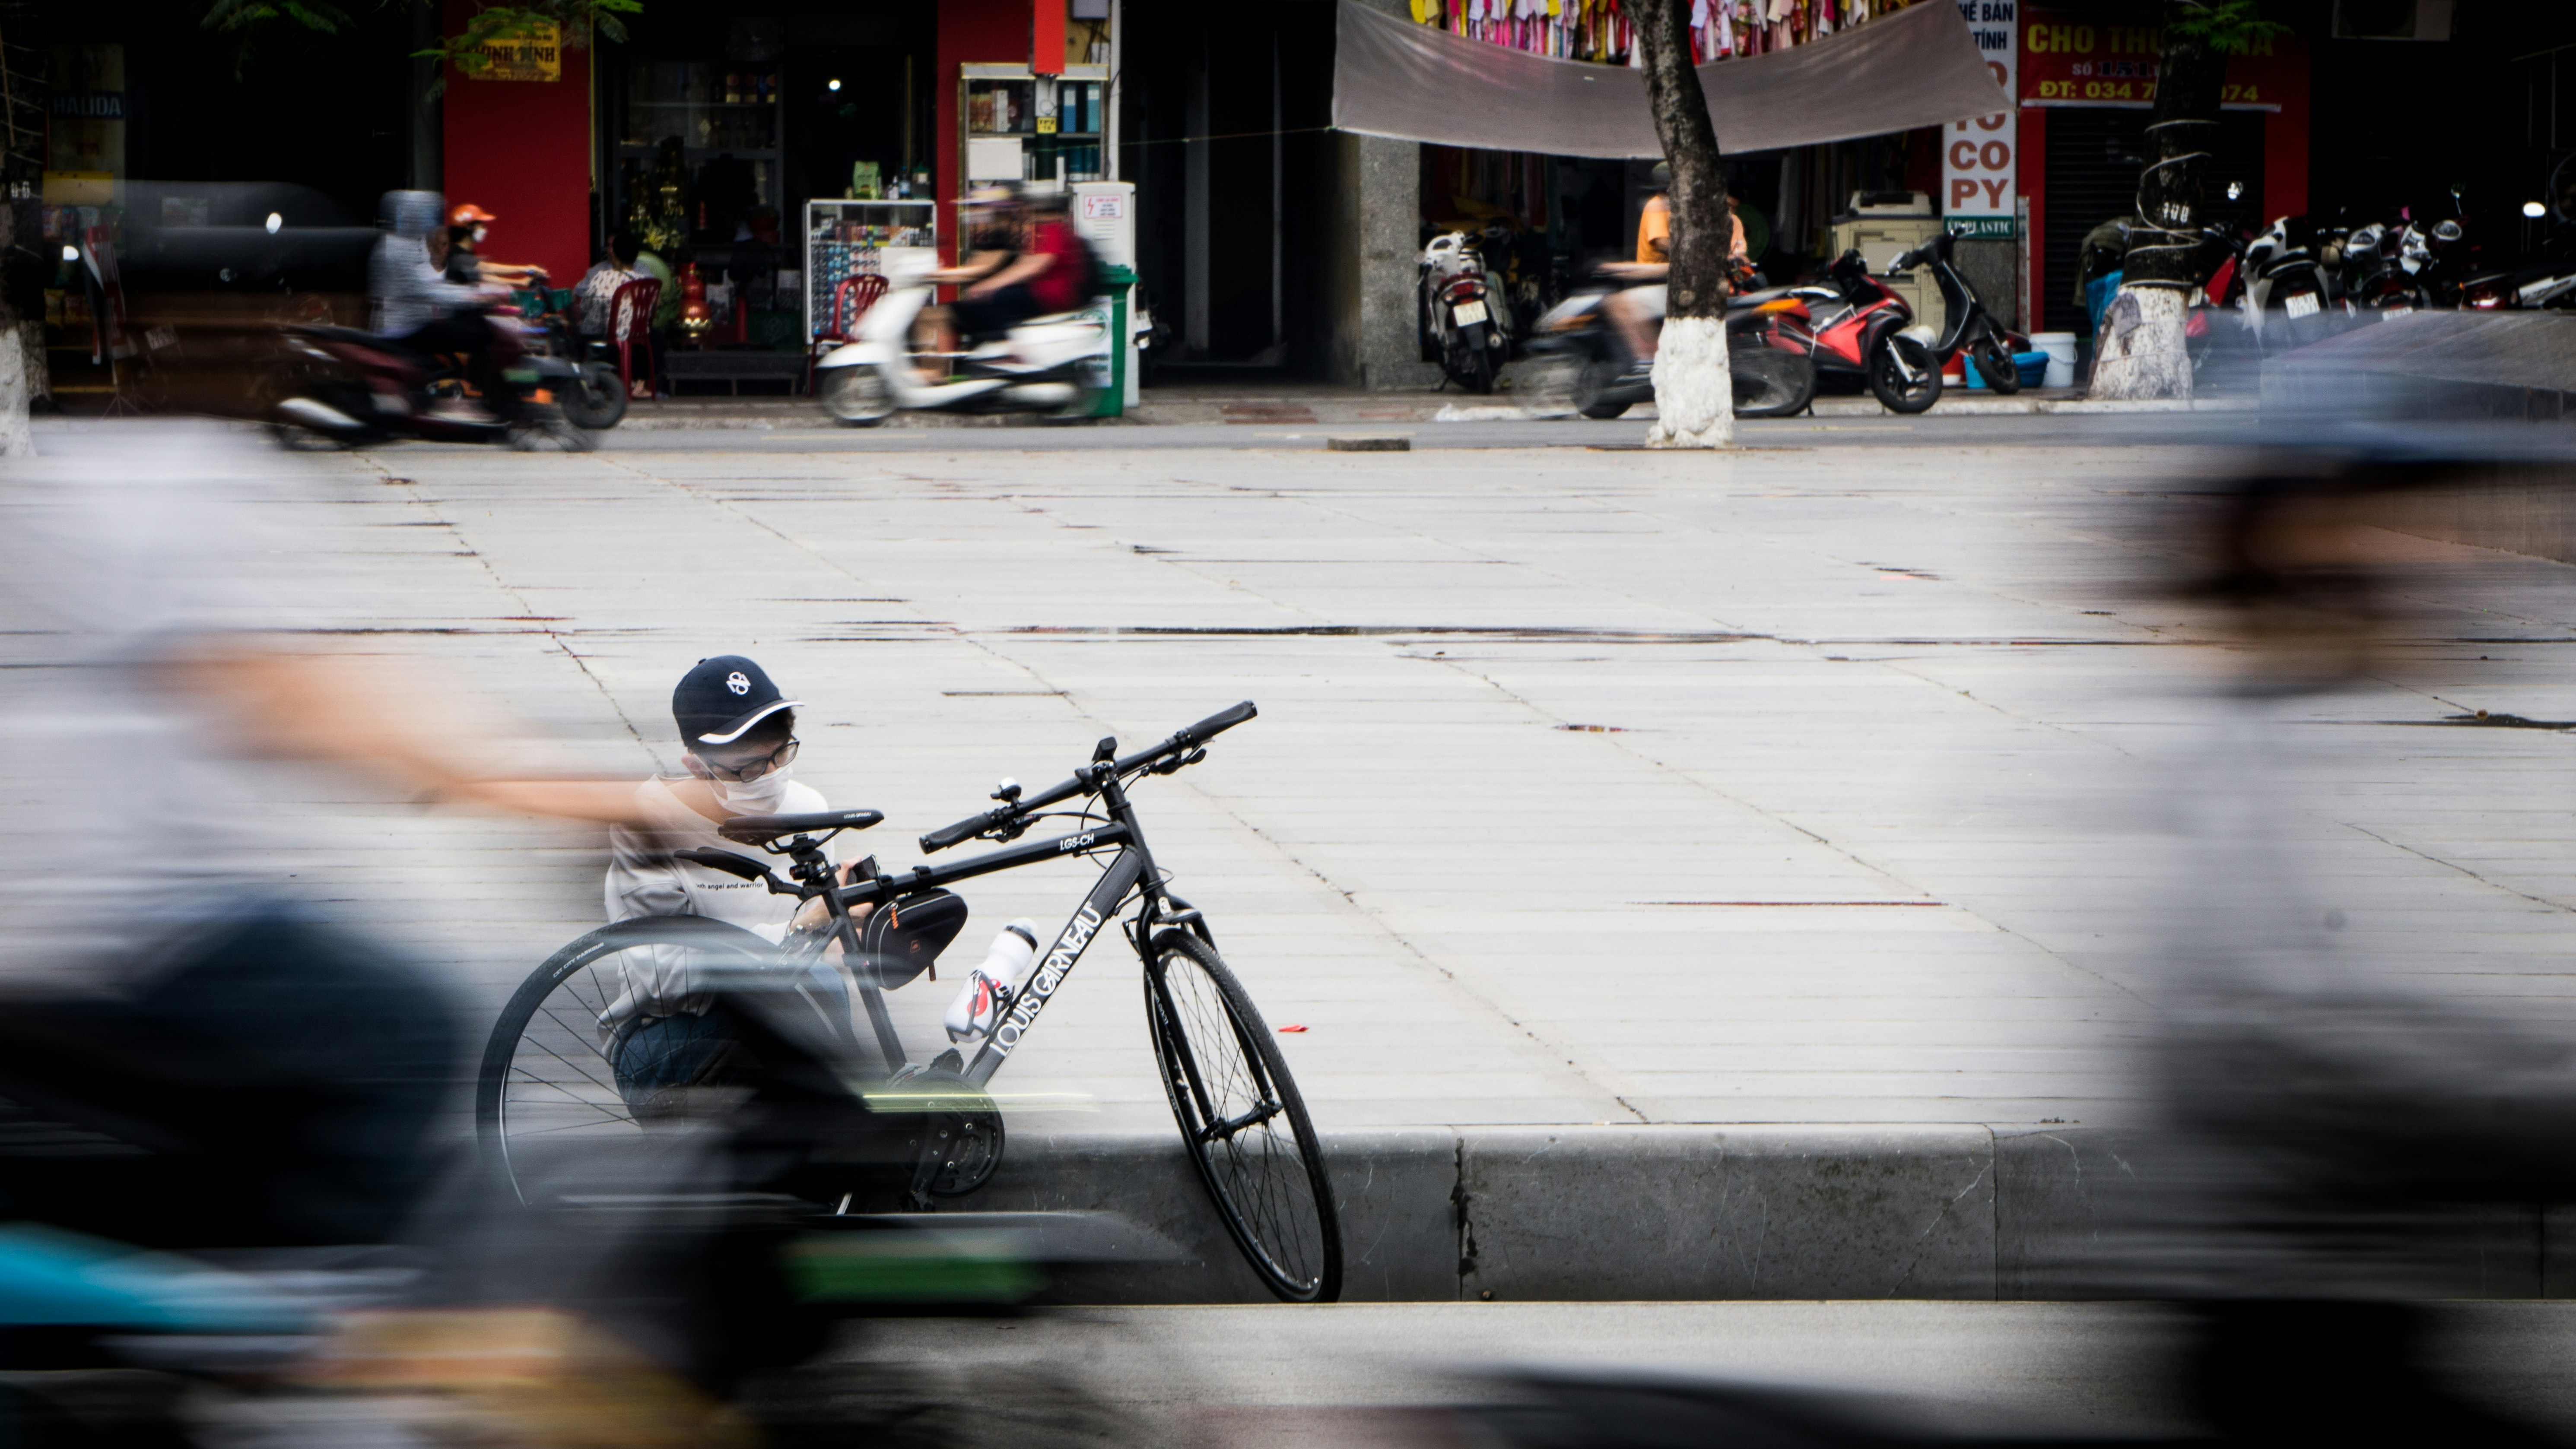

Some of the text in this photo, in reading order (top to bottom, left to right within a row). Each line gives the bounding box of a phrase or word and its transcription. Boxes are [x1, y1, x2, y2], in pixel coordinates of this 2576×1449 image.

[1972, 28, 2007, 50] TÍNH
[2026, 23, 2095, 54] CHO
[2107, 25, 2162, 54] THU
[2097, 60, 2152, 78] 151
[2039, 80, 2077, 98] ĐT:
[2085, 80, 2132, 99] 034
[52, 95, 122, 116] HALIDA
[1949, 140, 2010, 171] CO
[1951, 178, 2009, 209] PY
[1060, 833, 1094, 851] LGS-CH
[989, 906, 1102, 1057] LOUIS GARNEAU
